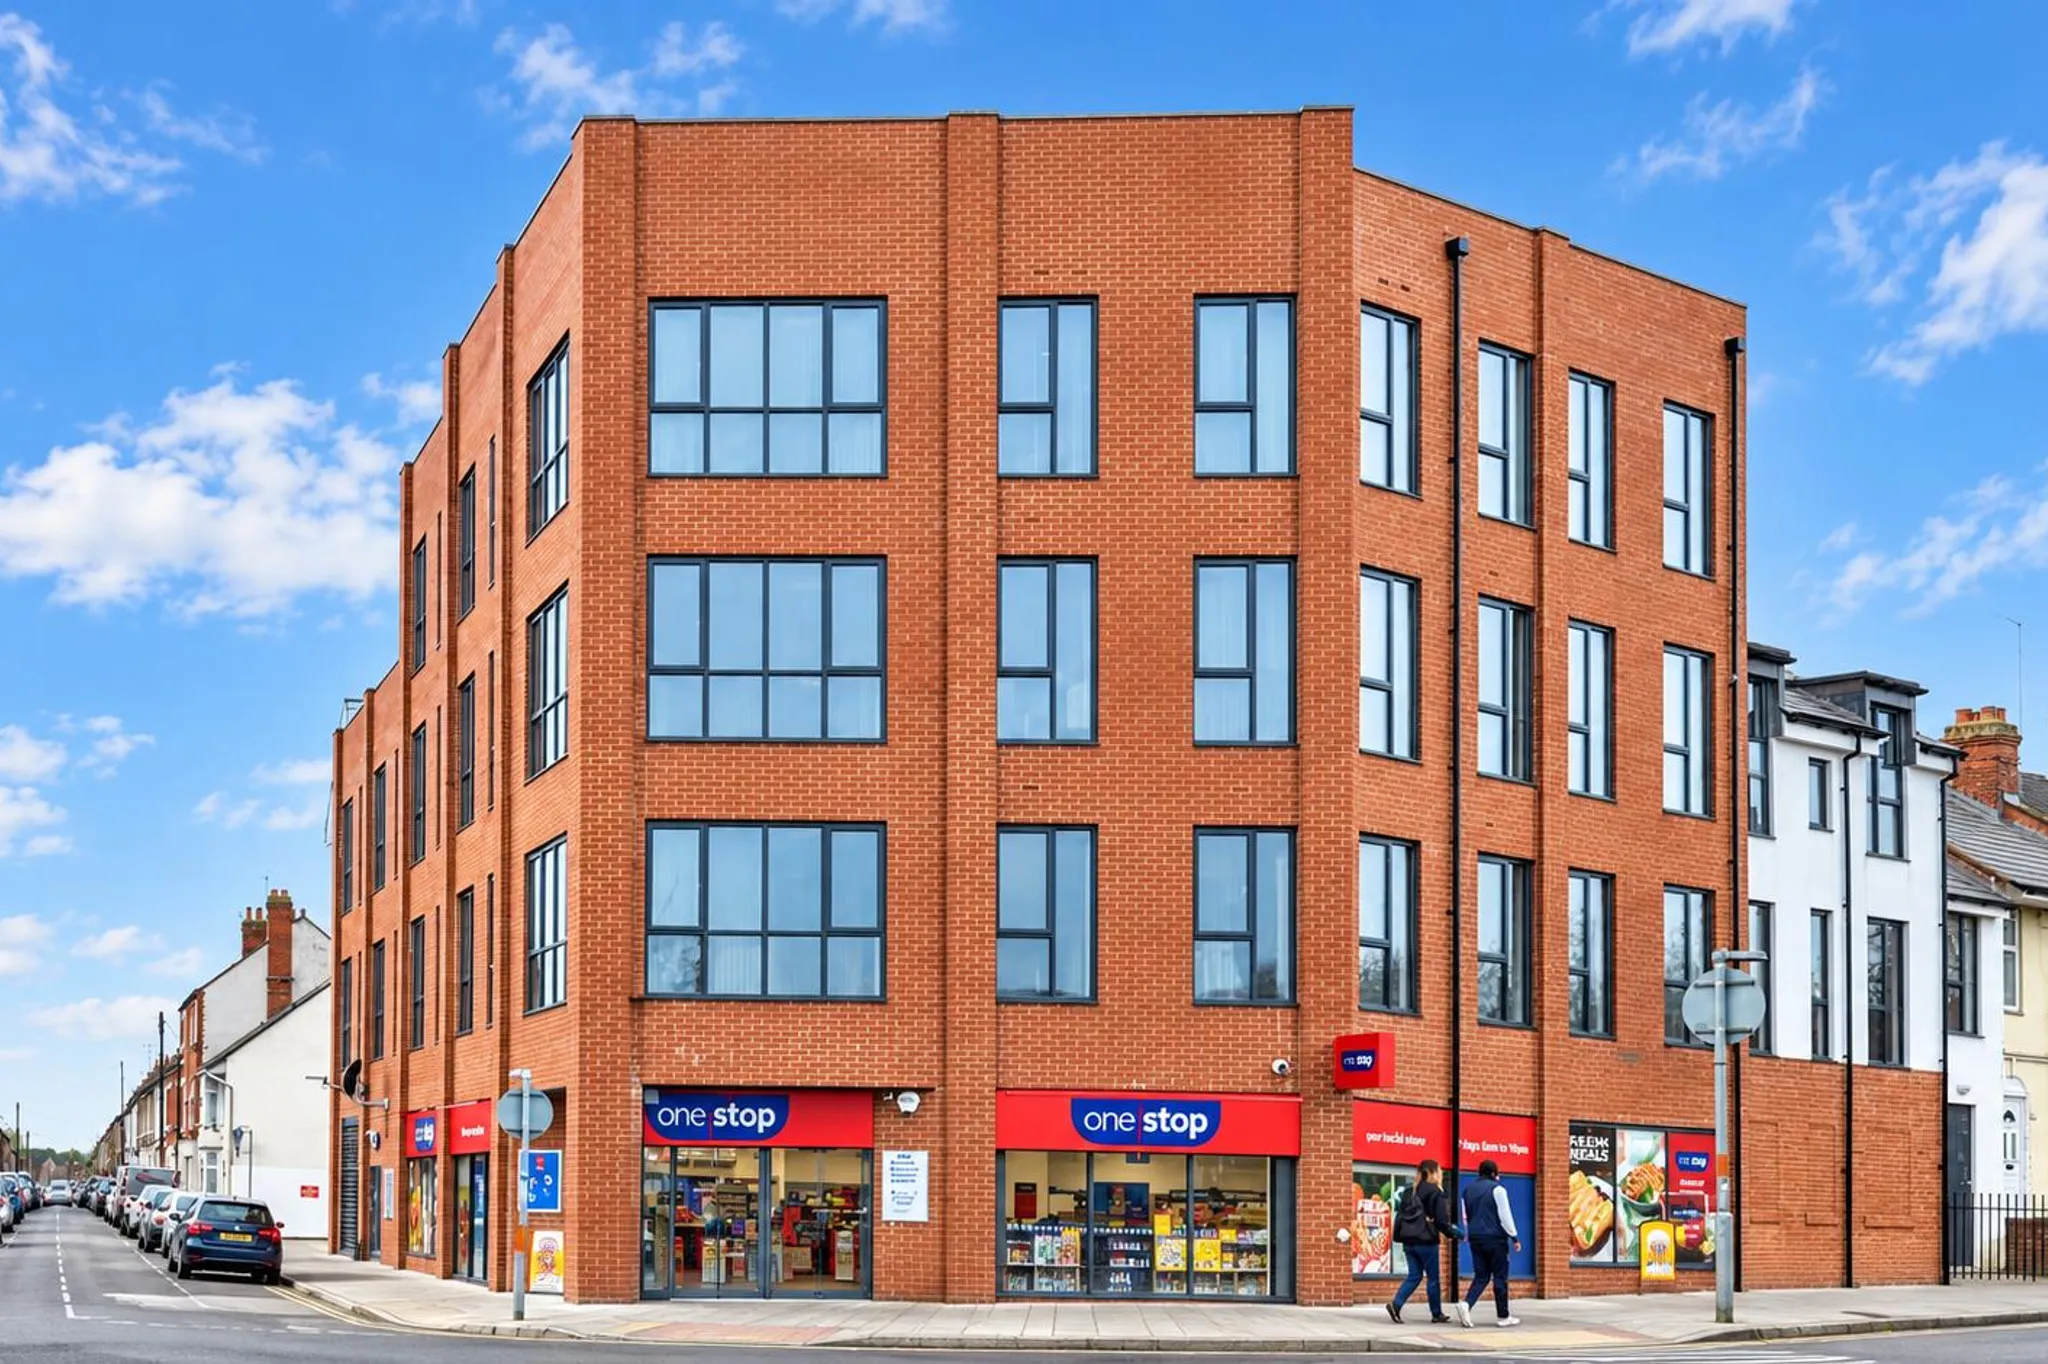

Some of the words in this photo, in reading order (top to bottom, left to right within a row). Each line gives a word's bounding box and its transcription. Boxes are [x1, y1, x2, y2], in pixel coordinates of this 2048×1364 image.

[657, 1107, 706, 1127] one
[713, 1101, 776, 1134] stop
[1083, 1111, 1136, 1132] one
[1142, 1106, 1208, 1140] stop
